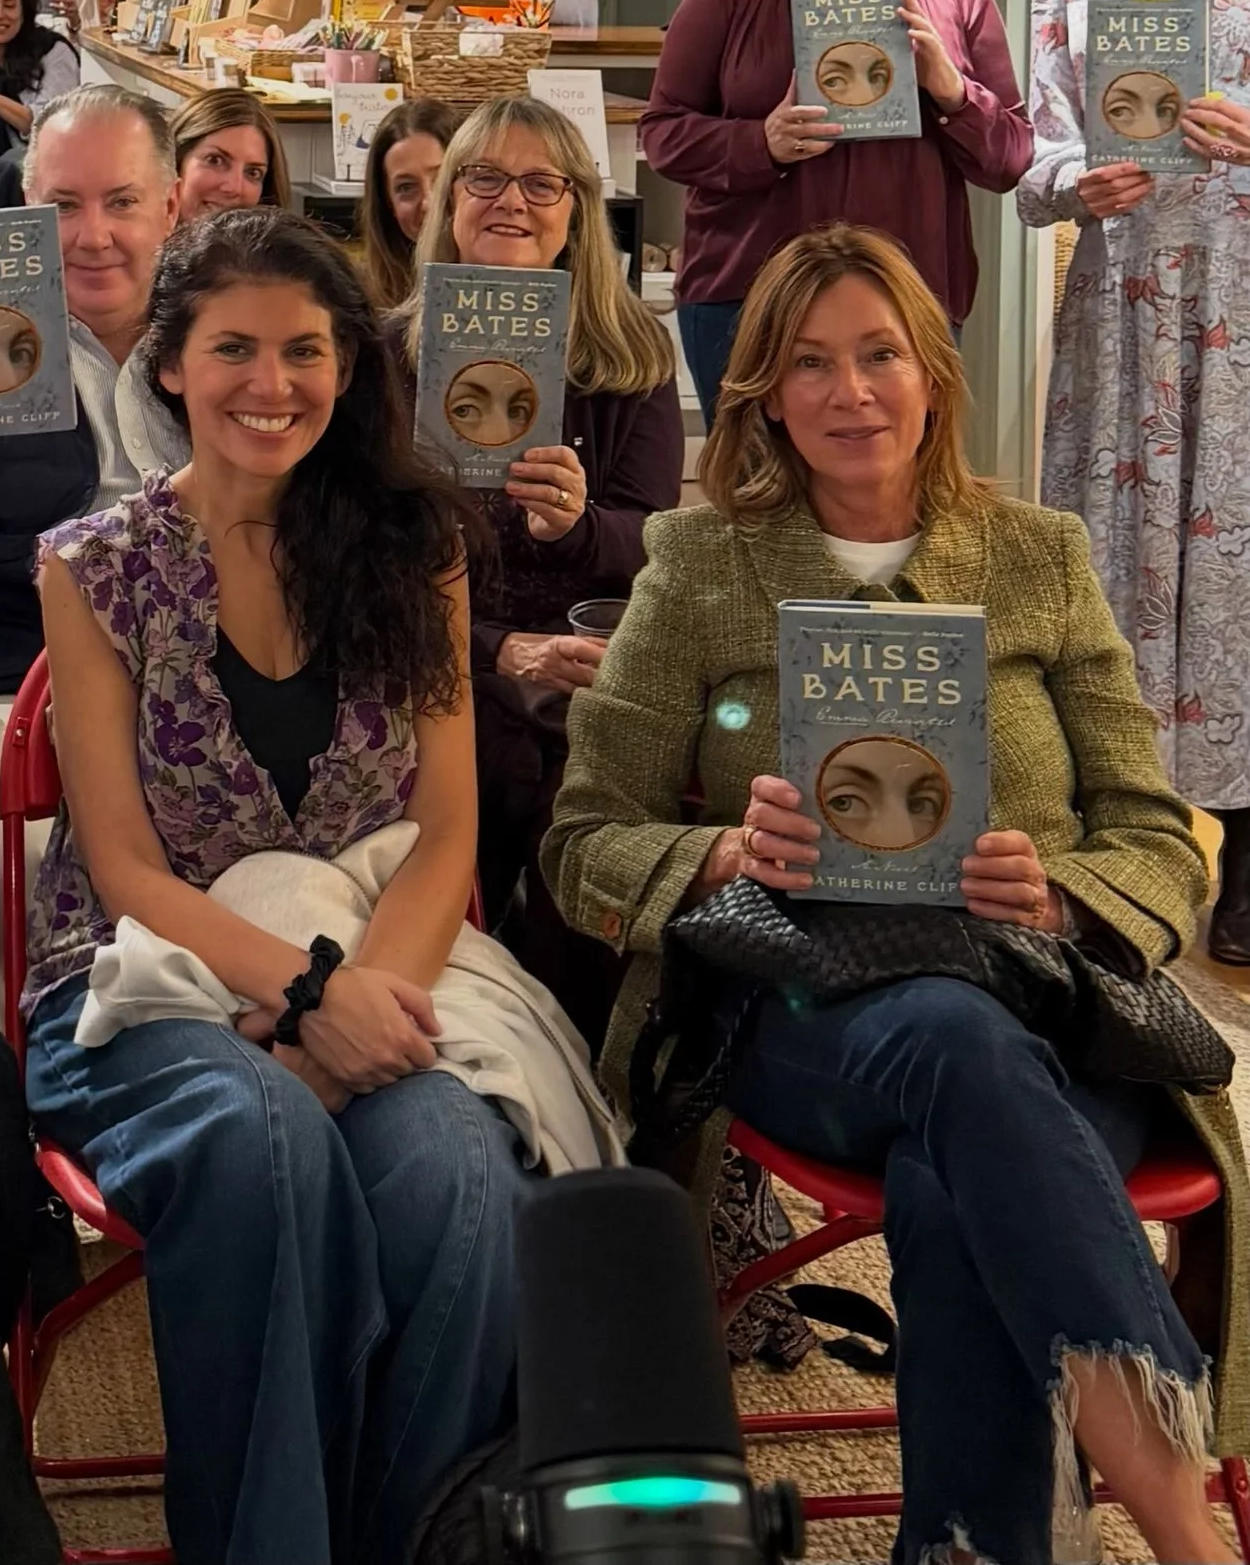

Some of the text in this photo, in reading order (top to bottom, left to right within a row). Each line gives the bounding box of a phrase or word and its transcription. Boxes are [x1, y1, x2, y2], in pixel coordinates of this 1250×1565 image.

[804, 5, 896, 26] BATES
[1108, 16, 1179, 33] MISS
[1096, 36, 1191, 52] BATES
[550, 88, 585, 99] Nora
[457, 289, 540, 312] MISS
[442, 313, 551, 337] BATES
[821, 642, 941, 672] MISS
[802, 673, 962, 705] BATES
[815, 876, 957, 893] ATHERINE CLIF
